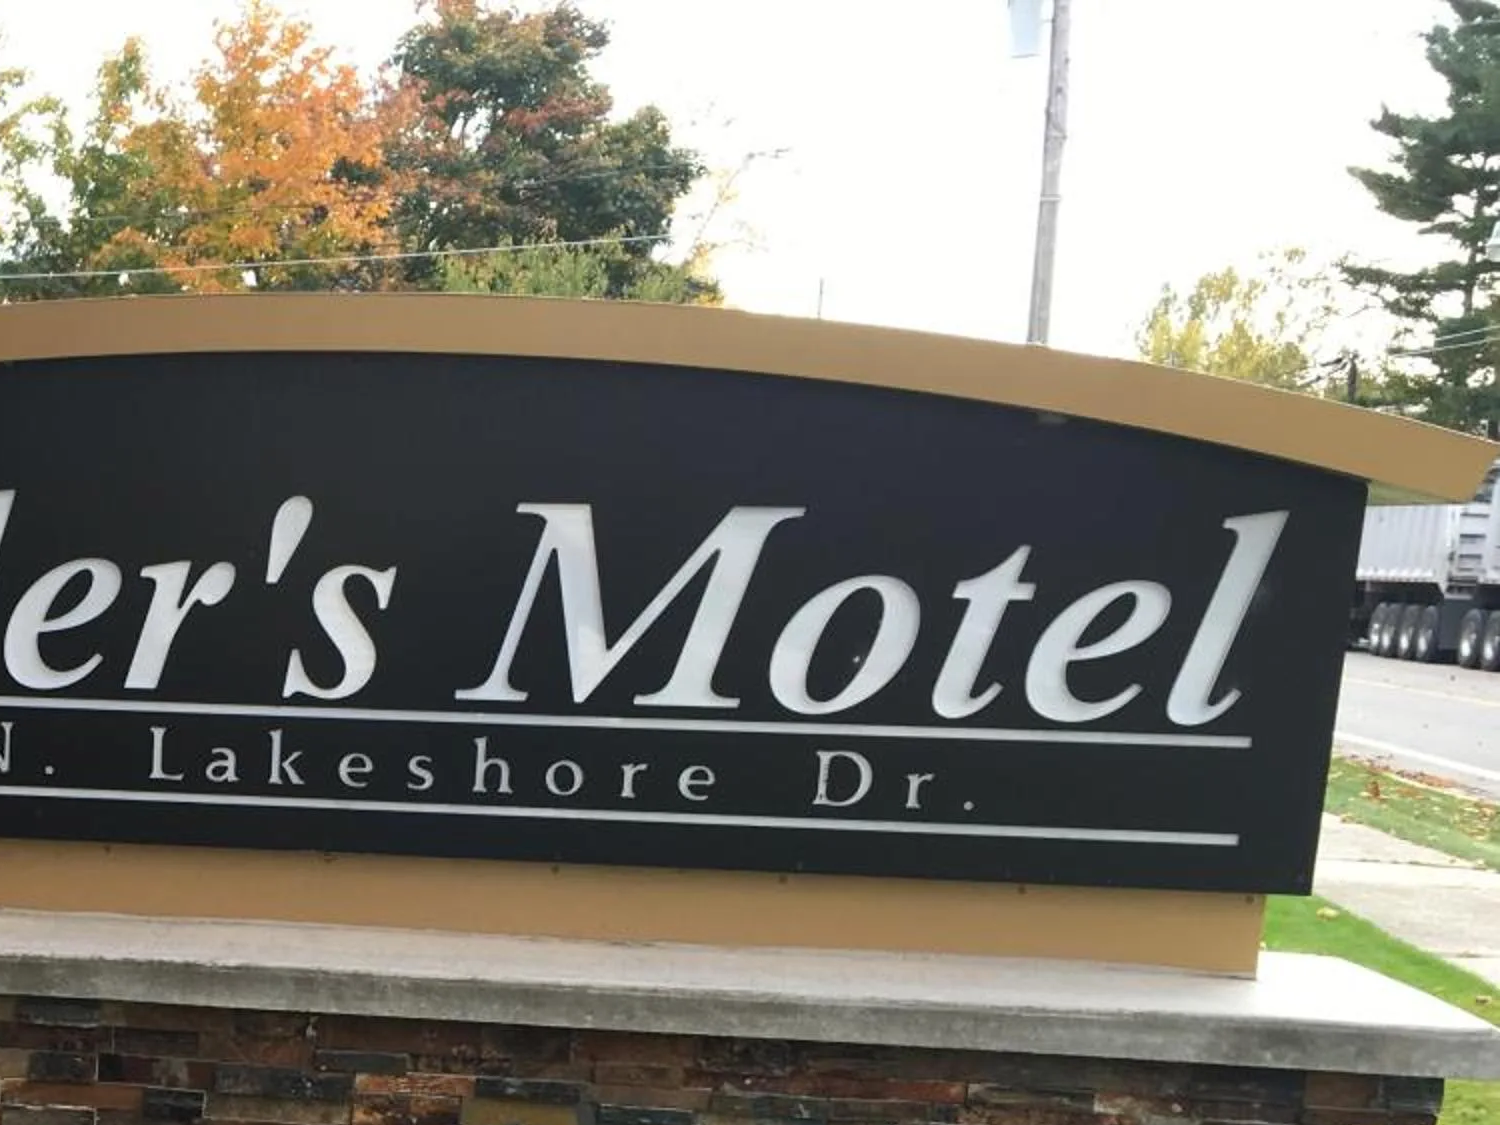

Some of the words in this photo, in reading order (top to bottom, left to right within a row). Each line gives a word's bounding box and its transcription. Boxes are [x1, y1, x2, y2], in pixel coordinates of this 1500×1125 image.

[454, 502, 1290, 727] Motel
[148, 727, 716, 801] Lakeshore
[812, 750, 976, 811] Dr.
